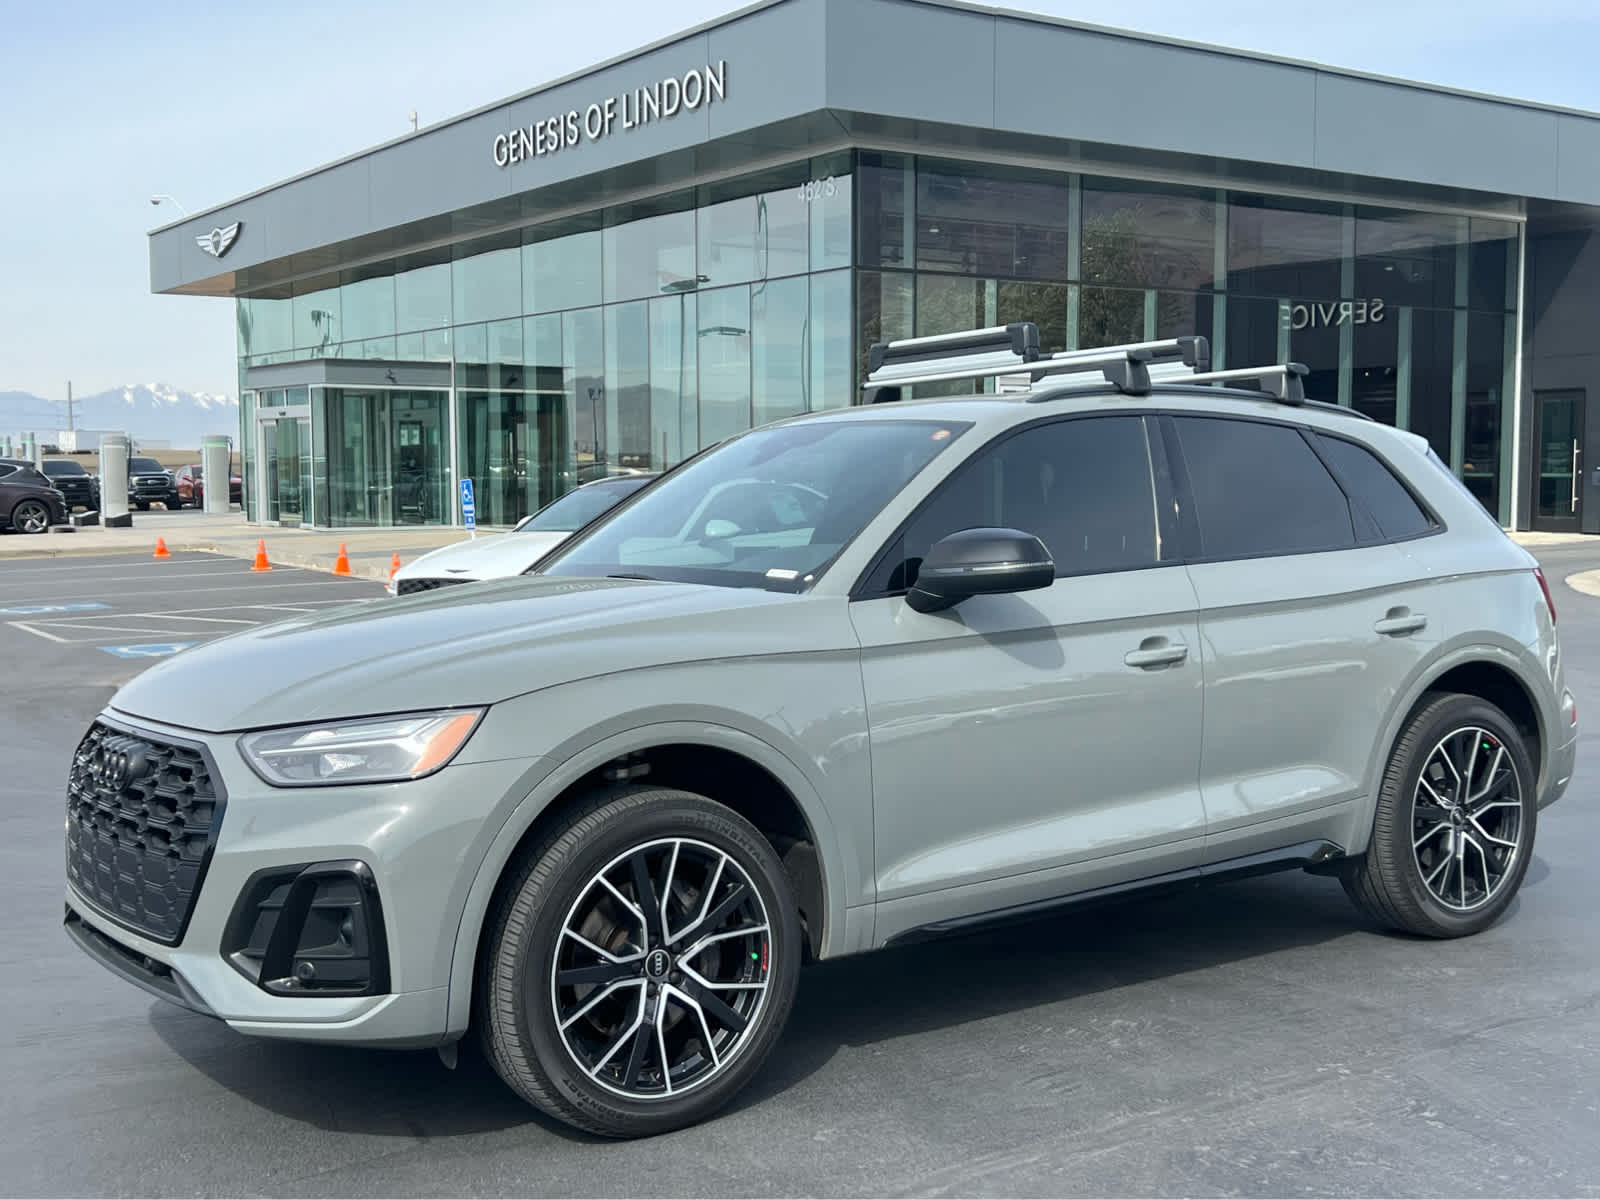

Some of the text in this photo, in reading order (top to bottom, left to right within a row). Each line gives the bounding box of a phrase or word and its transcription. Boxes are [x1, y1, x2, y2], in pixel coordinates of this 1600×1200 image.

[493, 60, 727, 167] GENESIS OF LINDON
